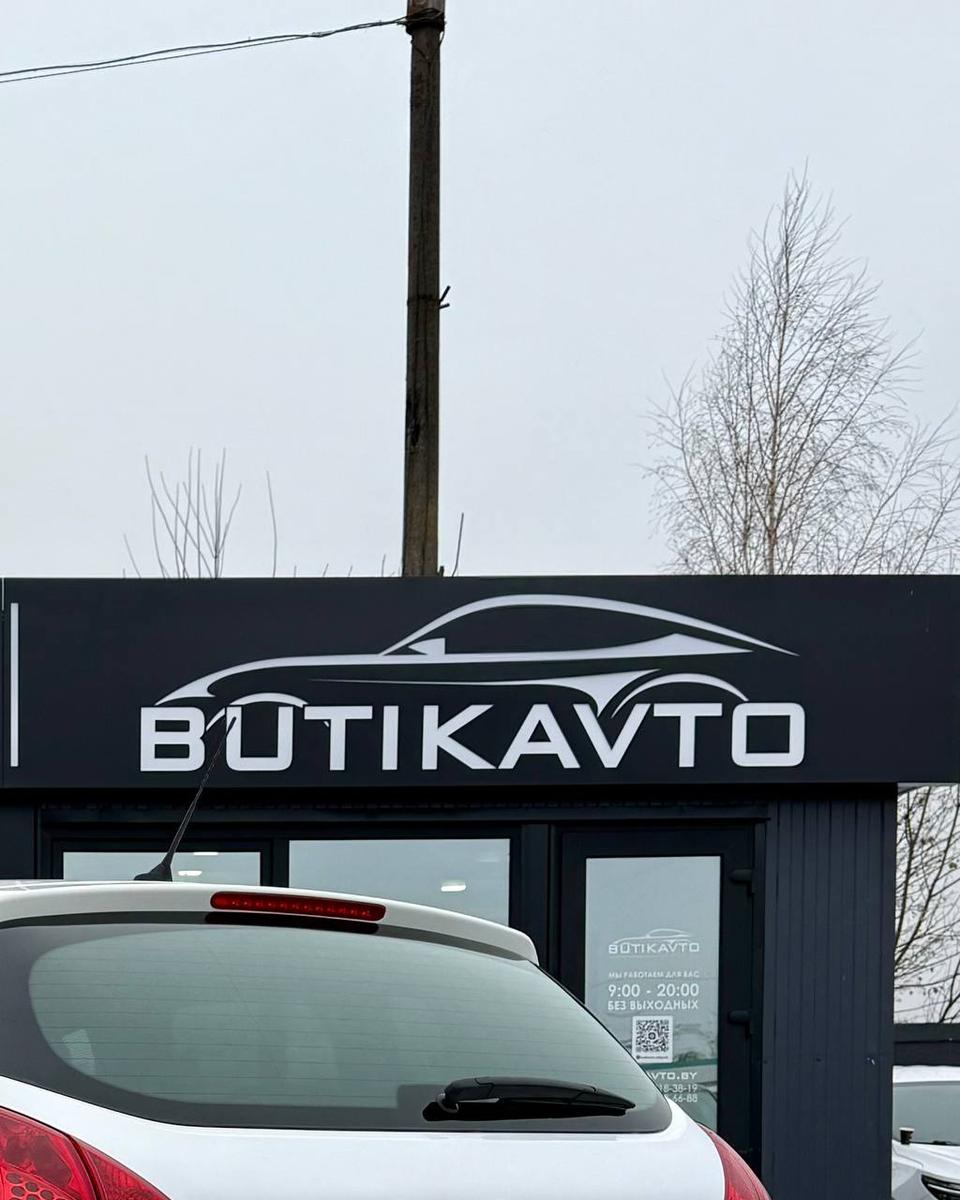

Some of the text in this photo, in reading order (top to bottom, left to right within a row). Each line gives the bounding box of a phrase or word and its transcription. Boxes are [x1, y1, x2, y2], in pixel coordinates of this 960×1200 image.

[140, 702, 806, 772] BUTIKAVTO
[609, 942, 700, 954] BUTIKAVTO
[608, 984, 640, 997] 9:00
[657, 983, 699, 997] 20:00
[607, 1000, 699, 1010] БЕЗ ВЫХОДНЫХ
[646, 1072, 698, 1080] VTO.BY
